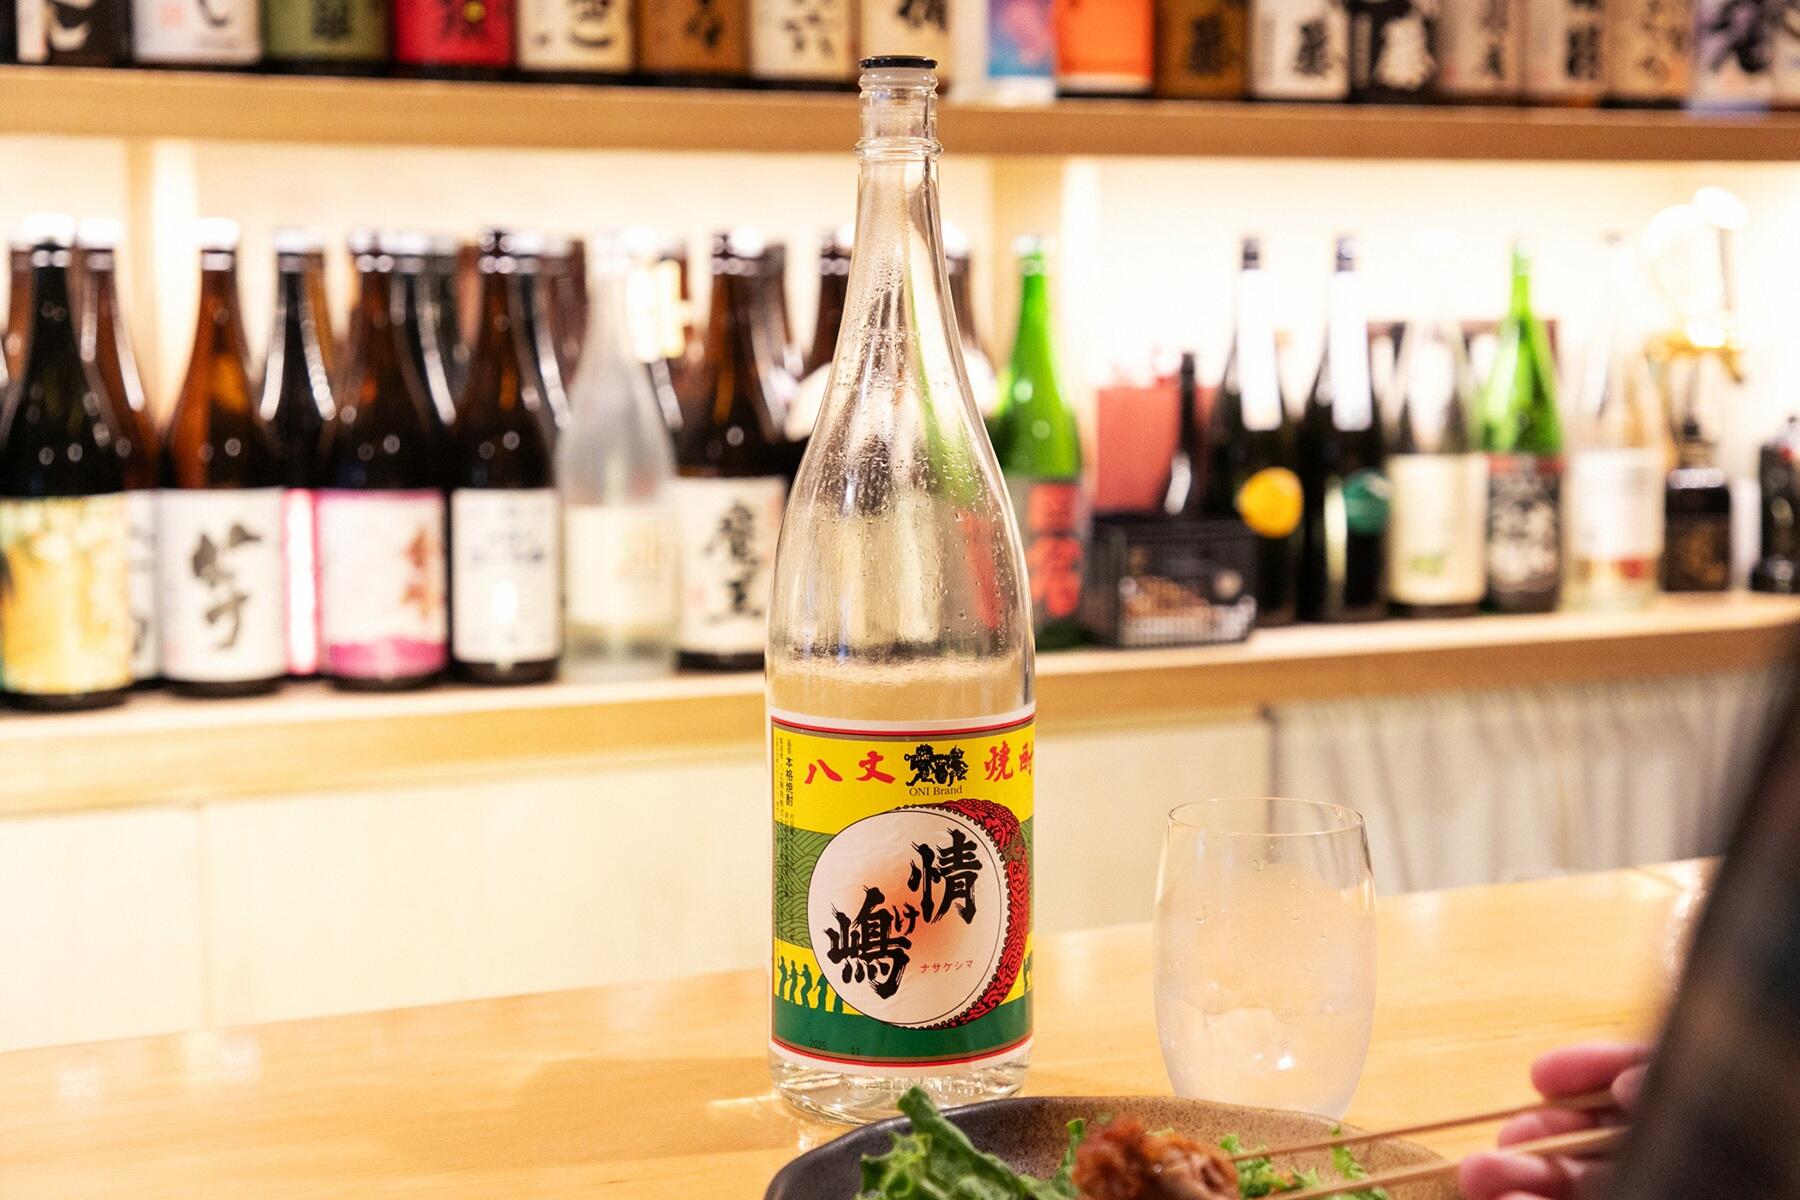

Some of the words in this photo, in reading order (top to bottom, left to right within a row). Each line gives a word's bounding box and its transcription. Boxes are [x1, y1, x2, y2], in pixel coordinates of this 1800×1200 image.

[804, 749, 897, 785] 八丈
[909, 787, 930, 797] ONI
[933, 785, 963, 796] Brand
[919, 960, 974, 974] ナサケシマ
